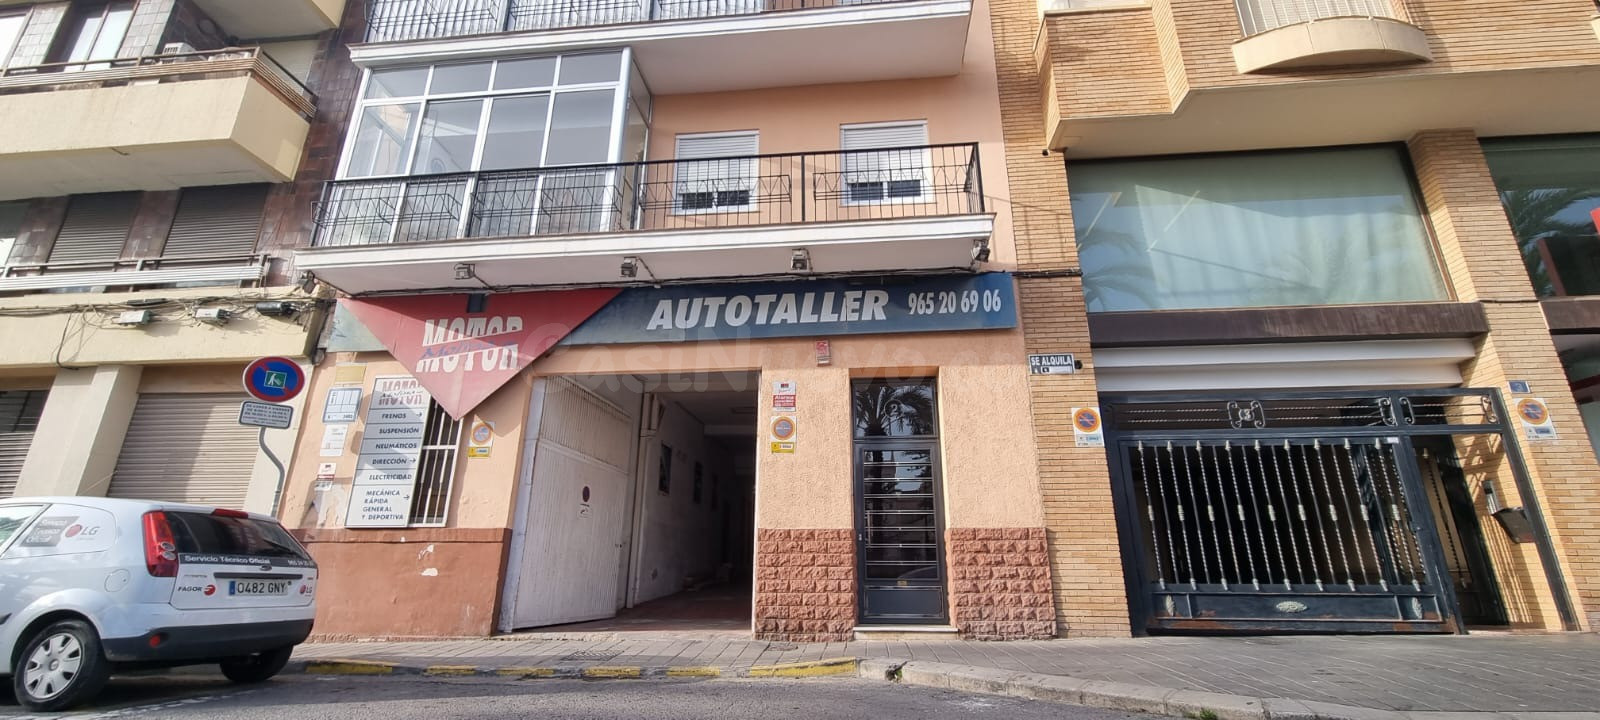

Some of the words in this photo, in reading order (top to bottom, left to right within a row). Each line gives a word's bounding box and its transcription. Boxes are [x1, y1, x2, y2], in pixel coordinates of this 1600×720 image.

[646, 290, 889, 330] AUTOTALLER
[908, 291, 935, 316] 965
[938, 291, 956, 315] 20
[961, 289, 980, 314] 69
[983, 288, 1002, 313] 06
[416, 316, 523, 373] MOTOR
[1031, 356, 1040, 366] SE
[1041, 355, 1072, 366] ALQUILA
[81, 526, 101, 536] LG
[237, 582, 265, 594] 0482
[268, 582, 286, 594] GNY
